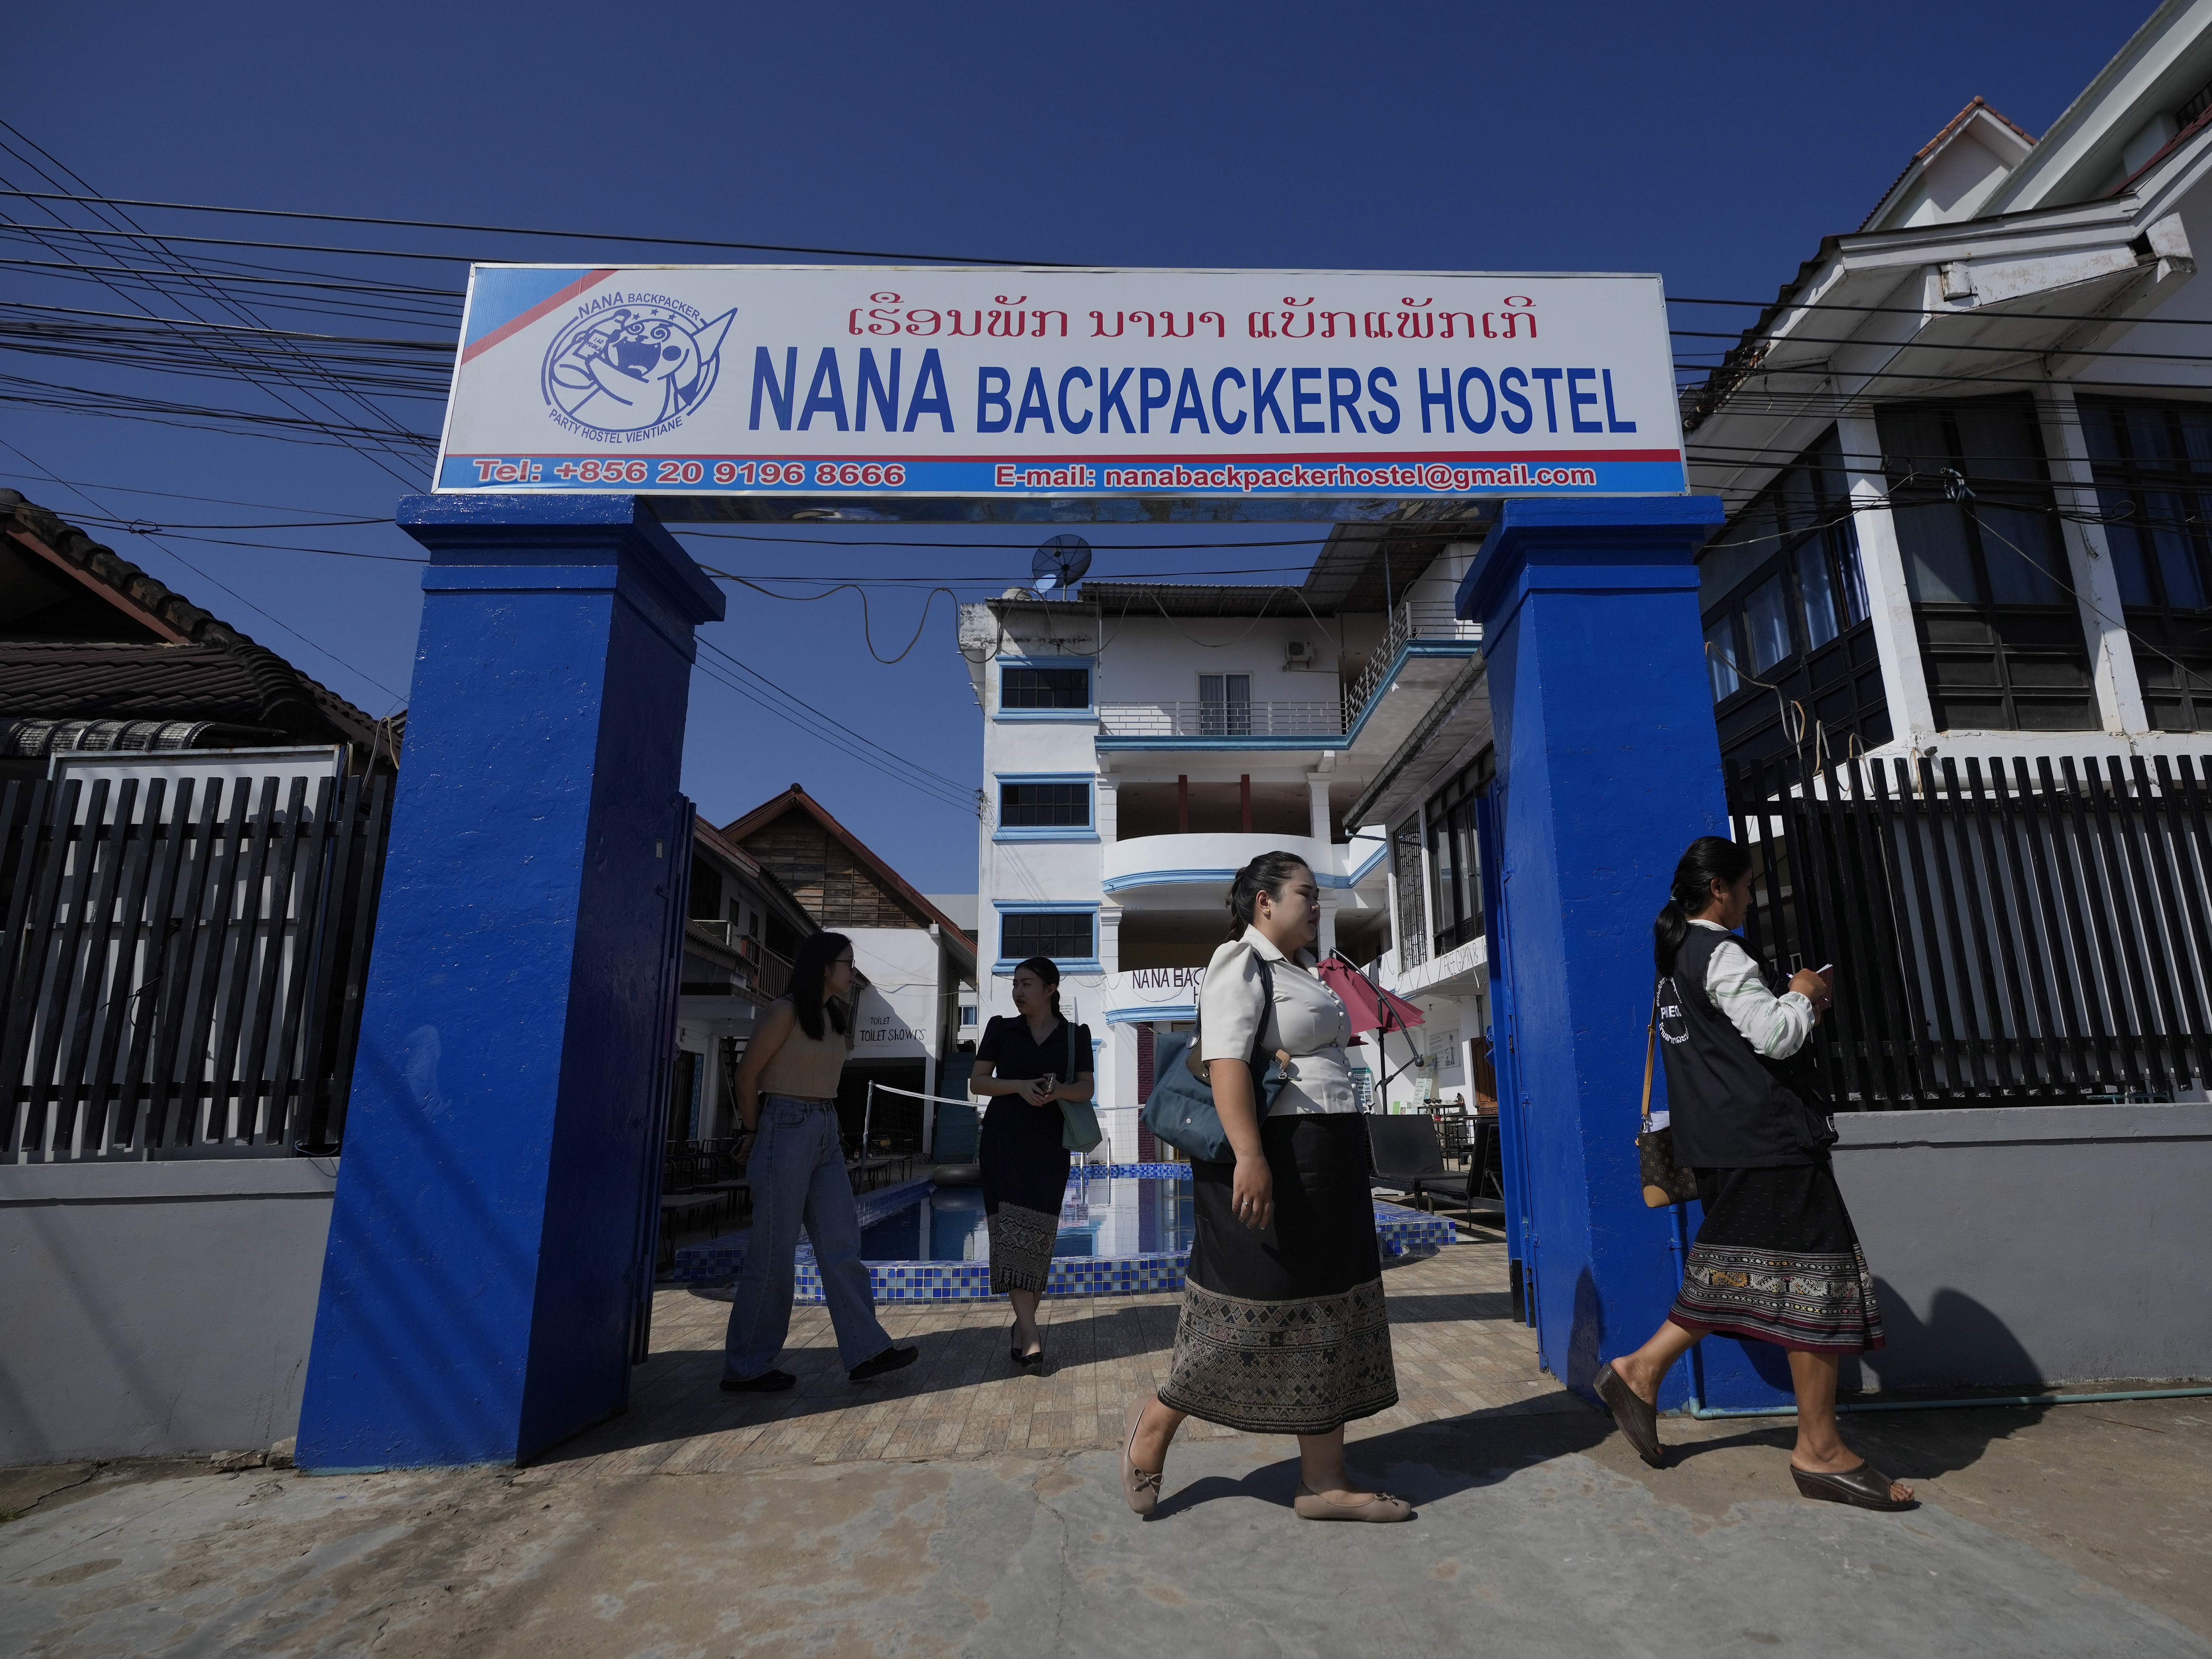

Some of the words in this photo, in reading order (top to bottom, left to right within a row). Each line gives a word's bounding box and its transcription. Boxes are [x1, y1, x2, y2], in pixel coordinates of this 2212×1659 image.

[578, 291, 624, 319] NANA
[628, 293, 700, 321] BACKPACKER
[1089, 311, 1225, 338] ນານາ
[749, 346, 955, 433] NANA
[977, 366, 1401, 435] BACKPACKERS
[1418, 366, 1637, 434] HOSTEL
[548, 408, 582, 434] PARTY
[581, 427, 622, 443] HOSTEL
[626, 416, 683, 443] VIENTIANE
[474, 460, 541, 482] Tel:
[556, 461, 646, 482] +856
[657, 462, 702, 482] 20
[715, 463, 804, 484] 9196
[816, 464, 904, 485] 8666
[996, 465, 1094, 485] E-mail:
[1106, 465, 1595, 489] nanabackpackerhostel@gmail.com
[1133, 968, 1169, 989] NANA
[1174, 967, 1207, 987] BAC
